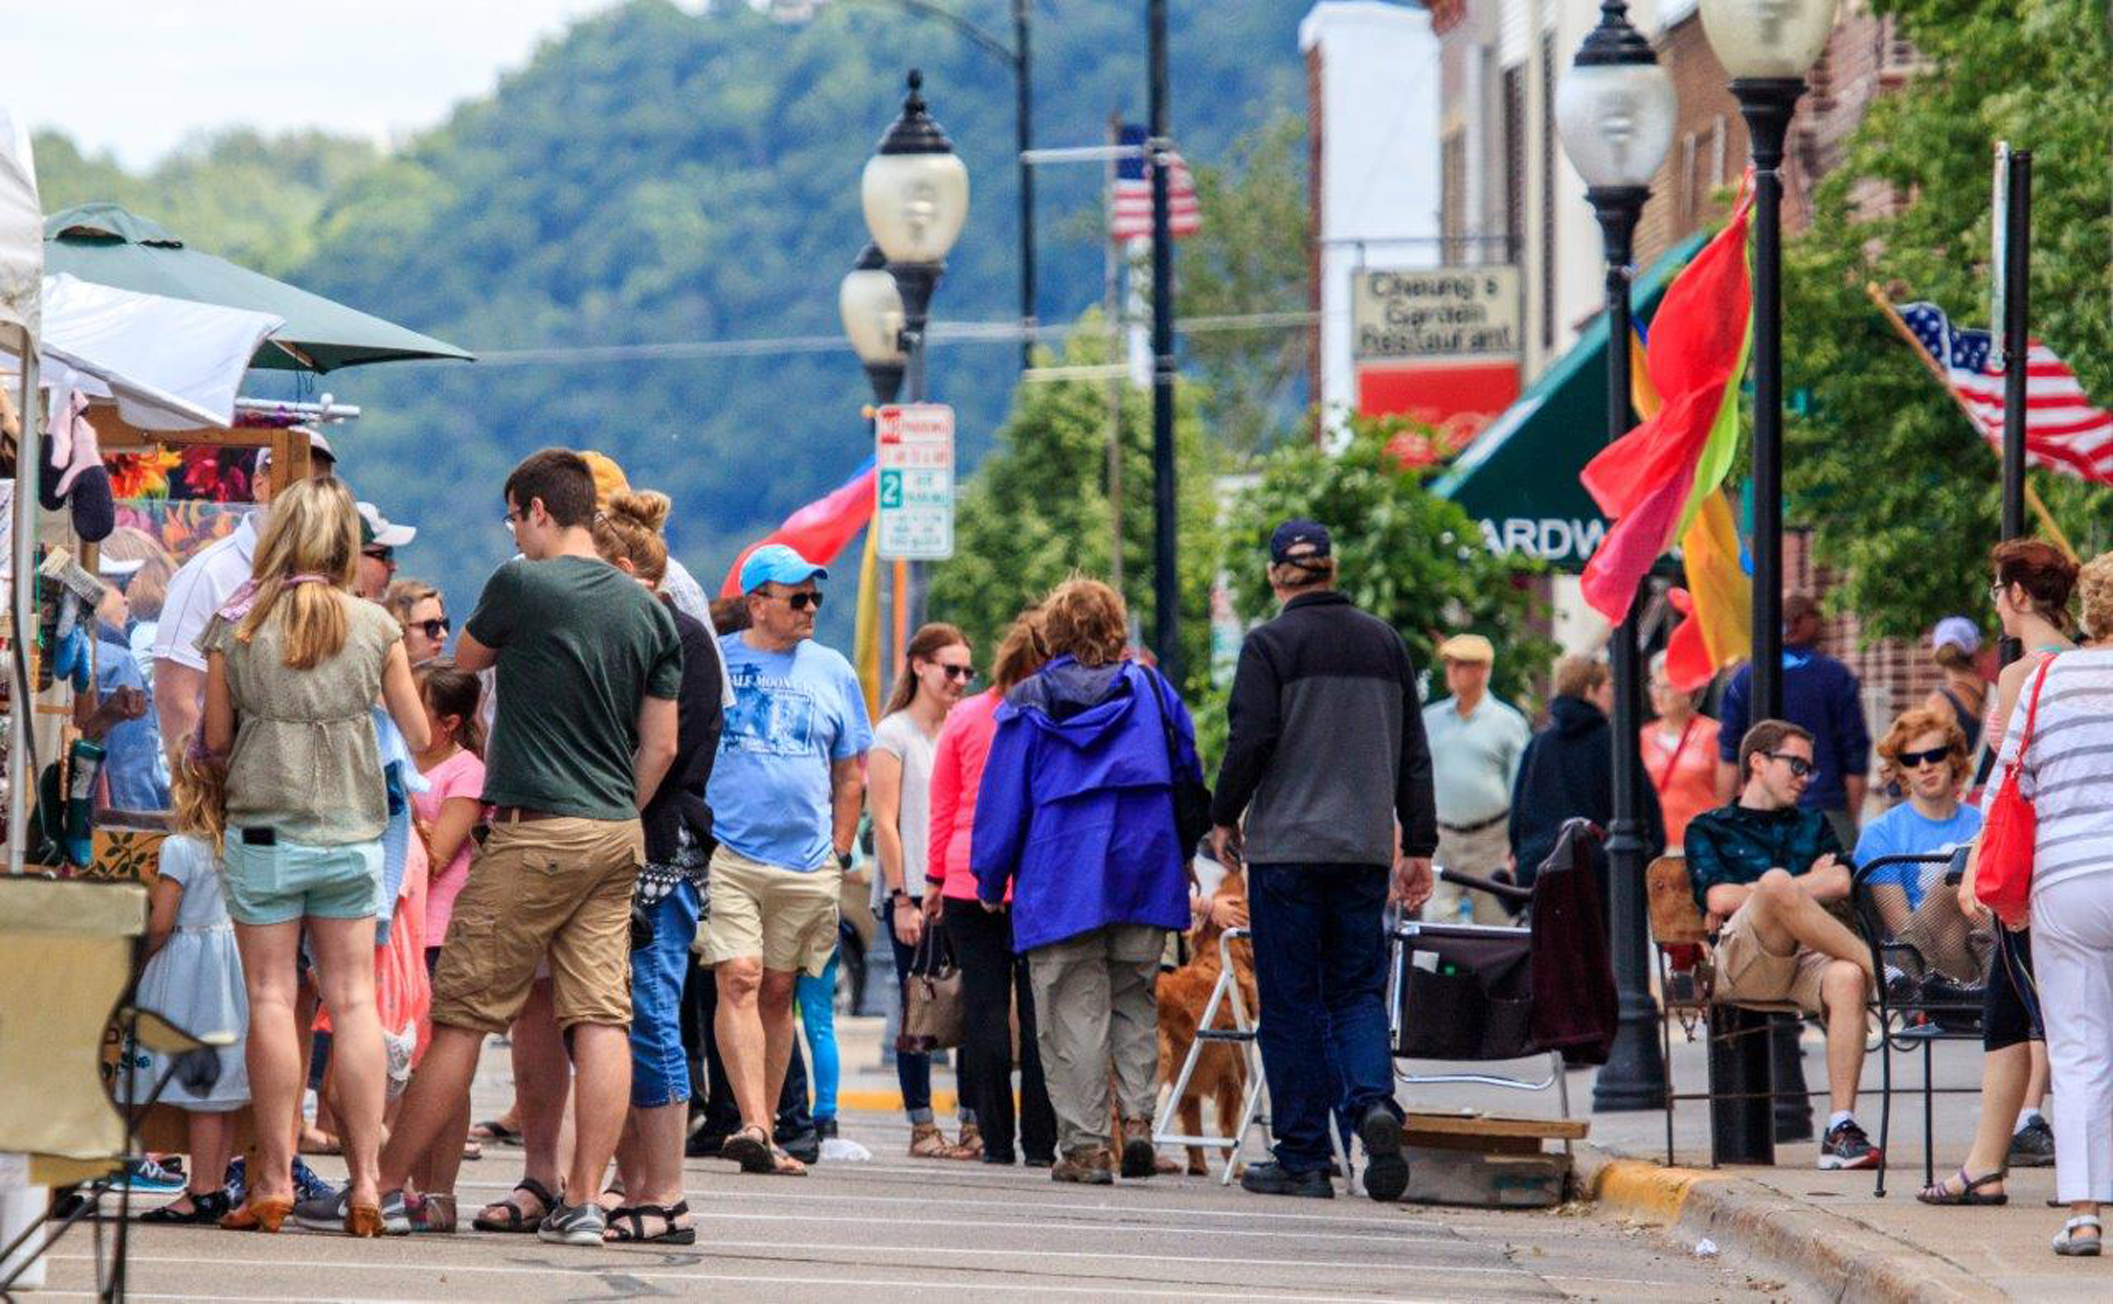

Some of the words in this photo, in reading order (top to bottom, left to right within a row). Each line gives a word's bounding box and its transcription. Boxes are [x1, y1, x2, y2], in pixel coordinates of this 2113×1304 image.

[1369, 271, 1498, 299] Cheungs
[882, 473, 899, 504] 2
[1478, 518, 1608, 560] ARDW
[727, 673, 752, 688] ALF
[755, 674, 791, 689] MOON
